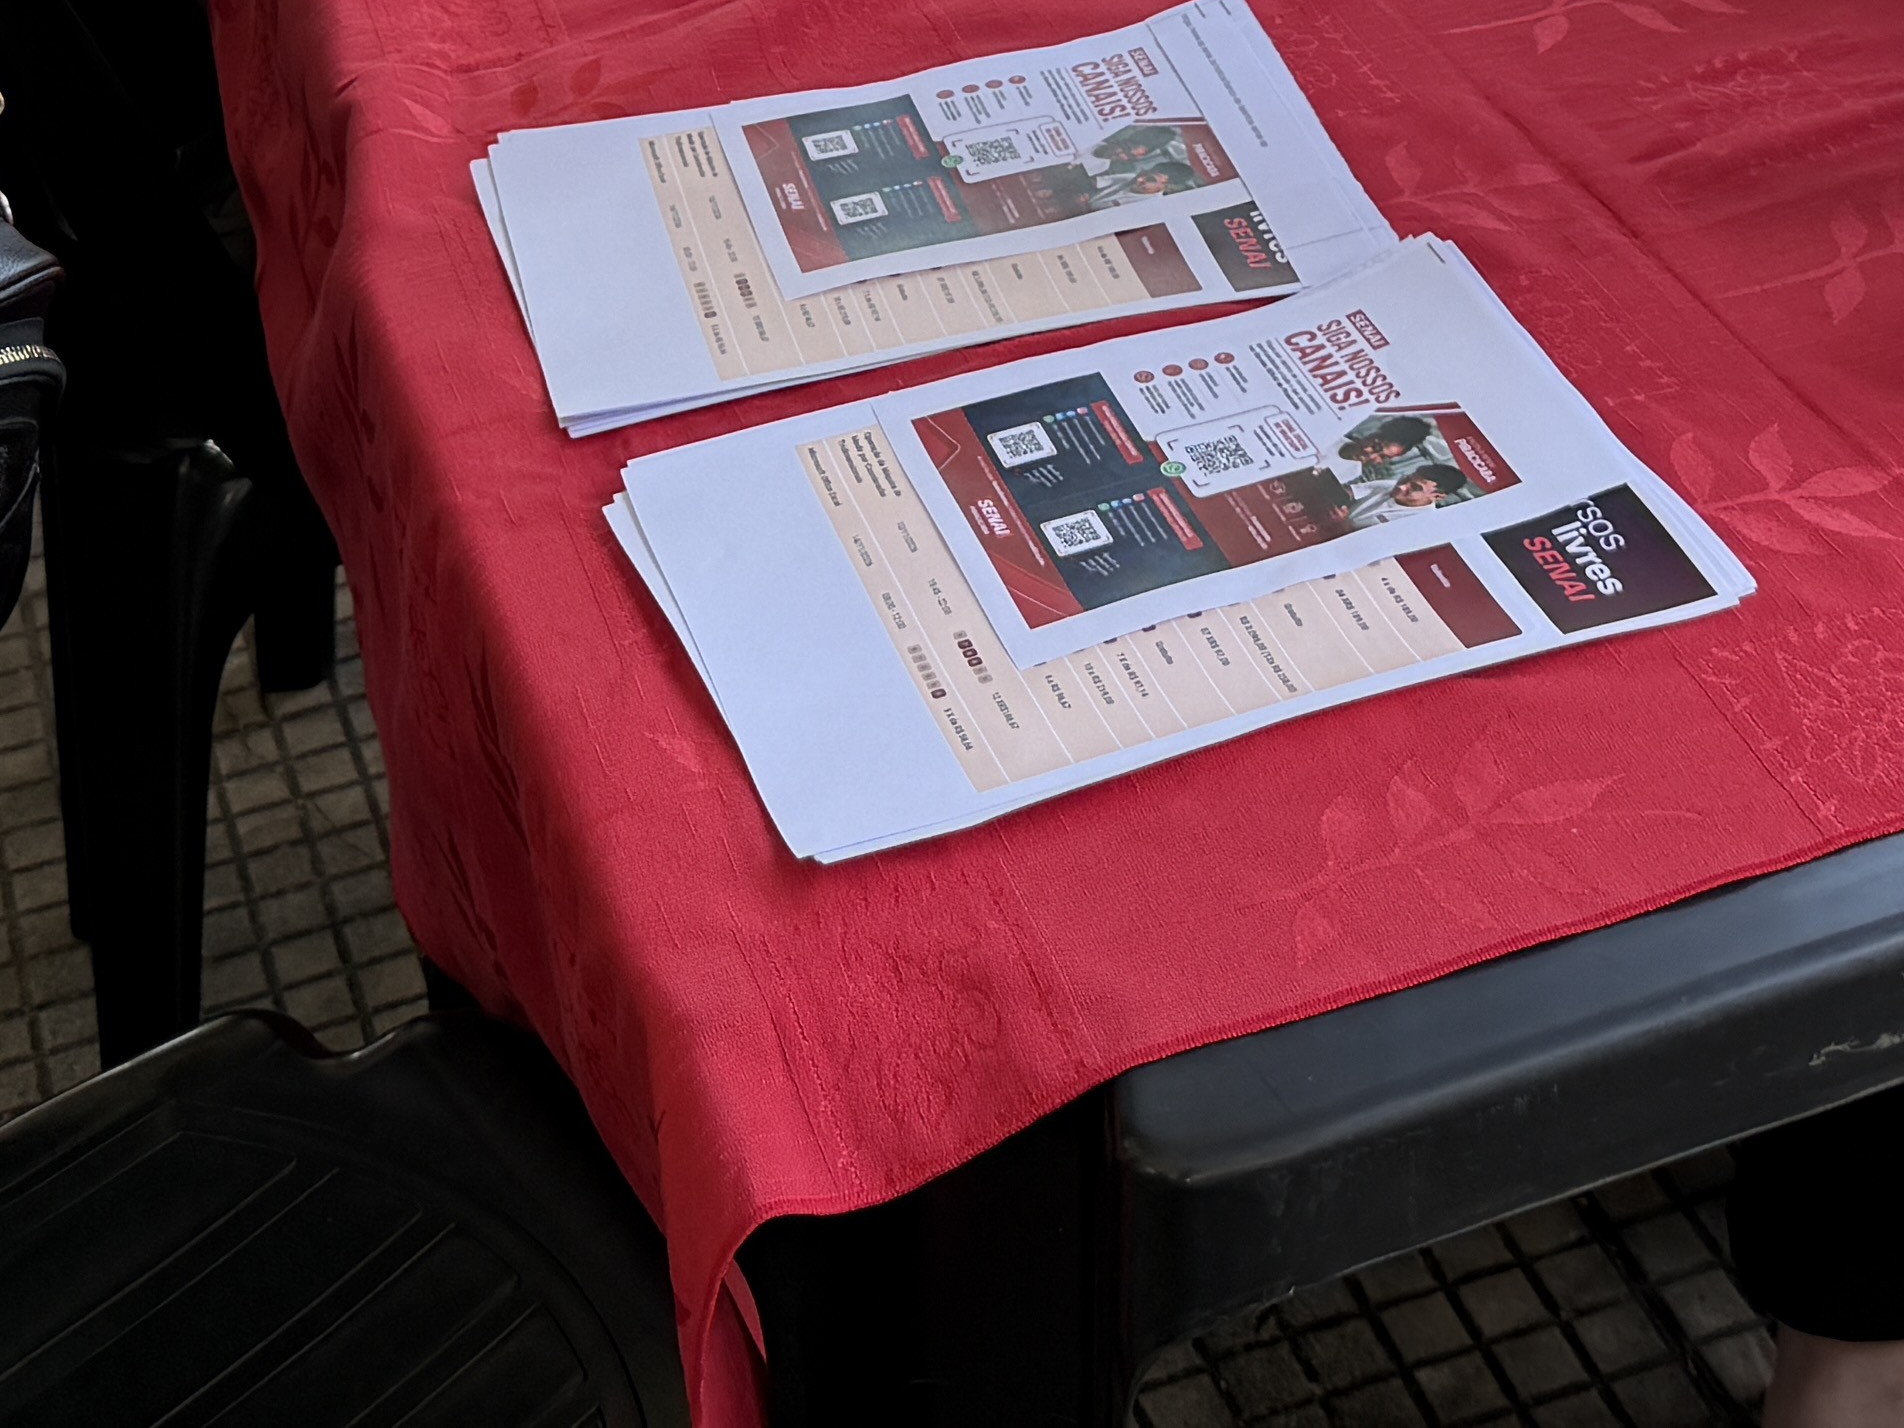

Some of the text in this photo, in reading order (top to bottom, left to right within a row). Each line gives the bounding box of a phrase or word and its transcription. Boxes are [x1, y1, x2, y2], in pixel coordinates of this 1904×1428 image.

[1071, 61, 1132, 123] CANAIS!
[1101, 53, 1127, 82] SIGA
[1224, 217, 1272, 270] SENAI
[1351, 312, 1387, 349] SENAI
[1284, 330, 1370, 411] CANAIS!
[1316, 318, 1401, 405] SIGA NOSSOS
[978, 498, 1010, 536] SENAI
[1569, 498, 1625, 551] rsos
[1523, 535, 1595, 602] SENAI
[1551, 520, 1624, 596] livres
